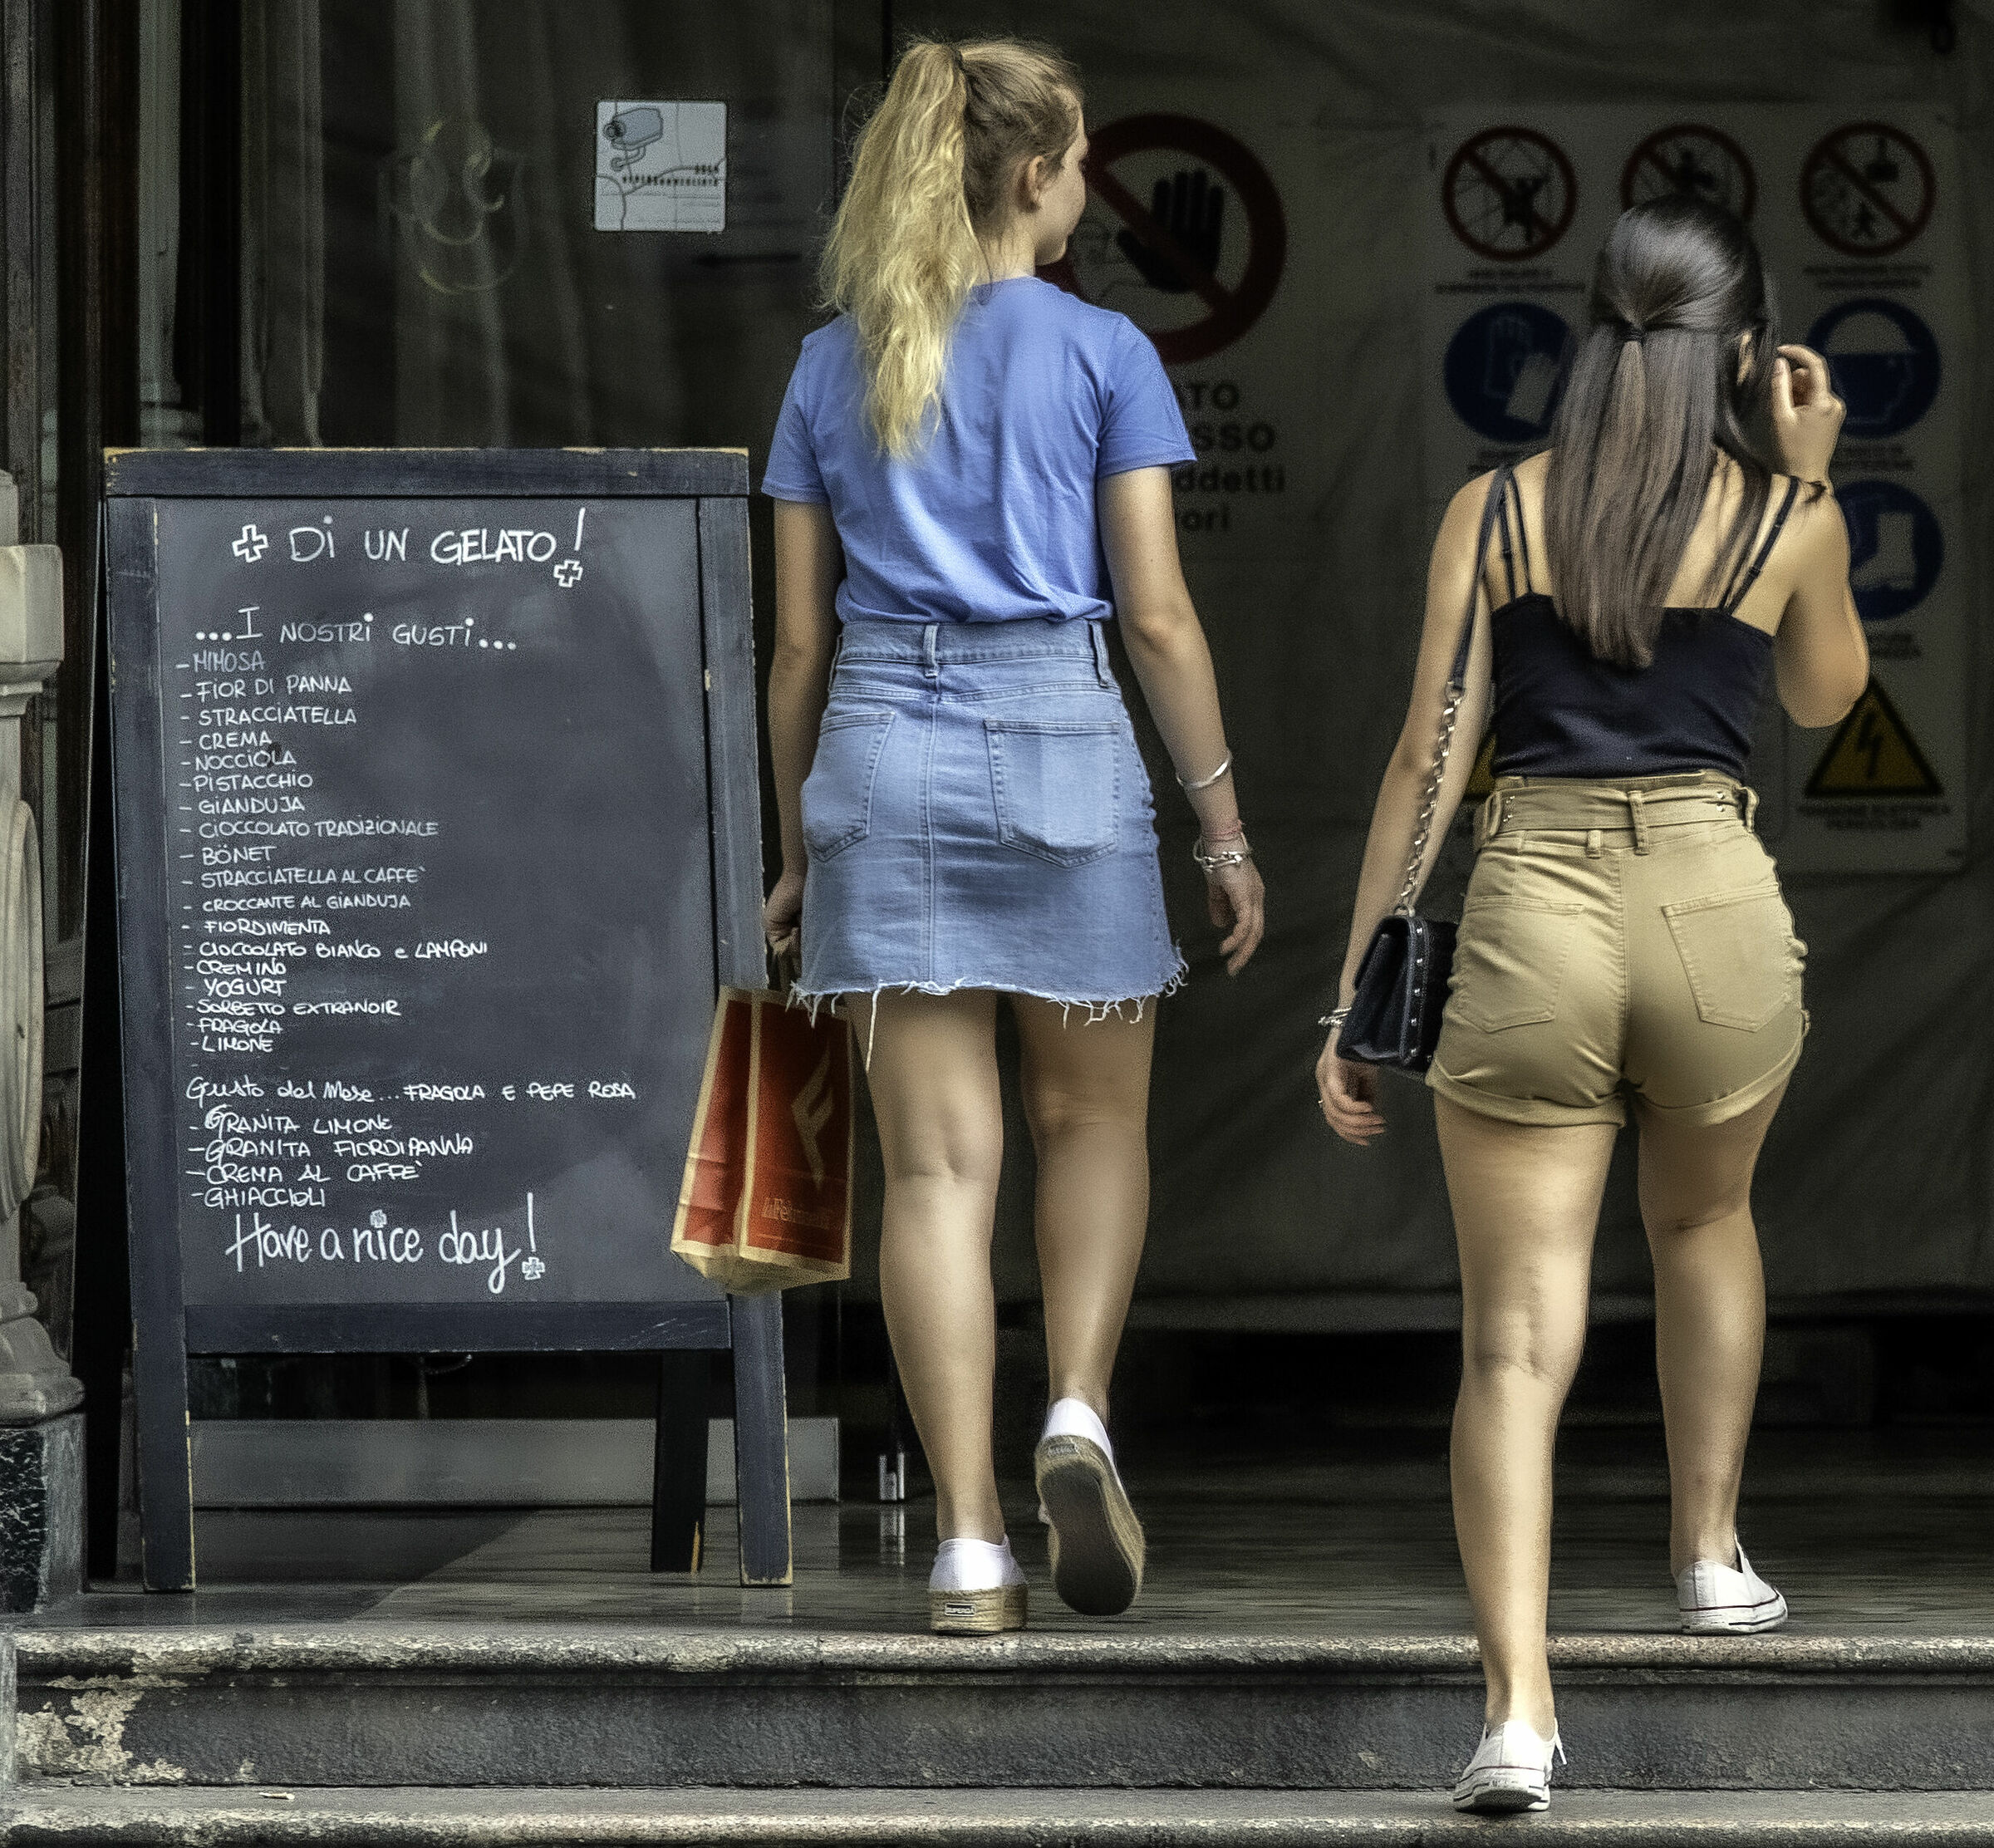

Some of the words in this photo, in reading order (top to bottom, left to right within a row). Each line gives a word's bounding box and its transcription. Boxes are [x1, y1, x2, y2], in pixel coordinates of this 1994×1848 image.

[365, 528, 409, 562] UN
[255, 678, 275, 696] DI
[287, 675, 353, 695] PANNA
[199, 731, 273, 750] CREMA
[341, 868, 362, 884] AL
[202, 895, 295, 913] CROCCANTE
[300, 895, 322, 910] AL
[199, 941, 307, 958] CIOCCOLATO
[316, 940, 381, 959] BIANCO
[394, 948, 408, 959] e
[196, 957, 286, 976] CREMINO
[204, 978, 287, 997] YOGURT
[196, 999, 286, 1016] SORBETTO
[293, 999, 402, 1016] EXTRANOIR
[198, 1019, 283, 1035] FRAGOLA
[202, 1035, 273, 1053] LIMONE
[185, 1074, 265, 1108] Gusto
[277, 1079, 316, 1099] del
[503, 1085, 517, 1101] E
[527, 1083, 575, 1101] PEPE
[588, 1082, 636, 1100] ROSA
[313, 1113, 393, 1134] LIMONE
[205, 1138, 312, 1166] GRANITA
[206, 1163, 283, 1184] CREMA
[298, 1164, 331, 1182] AL
[225, 1212, 312, 1272] Have
[321, 1226, 344, 1261] a
[355, 1209, 424, 1263] nice
